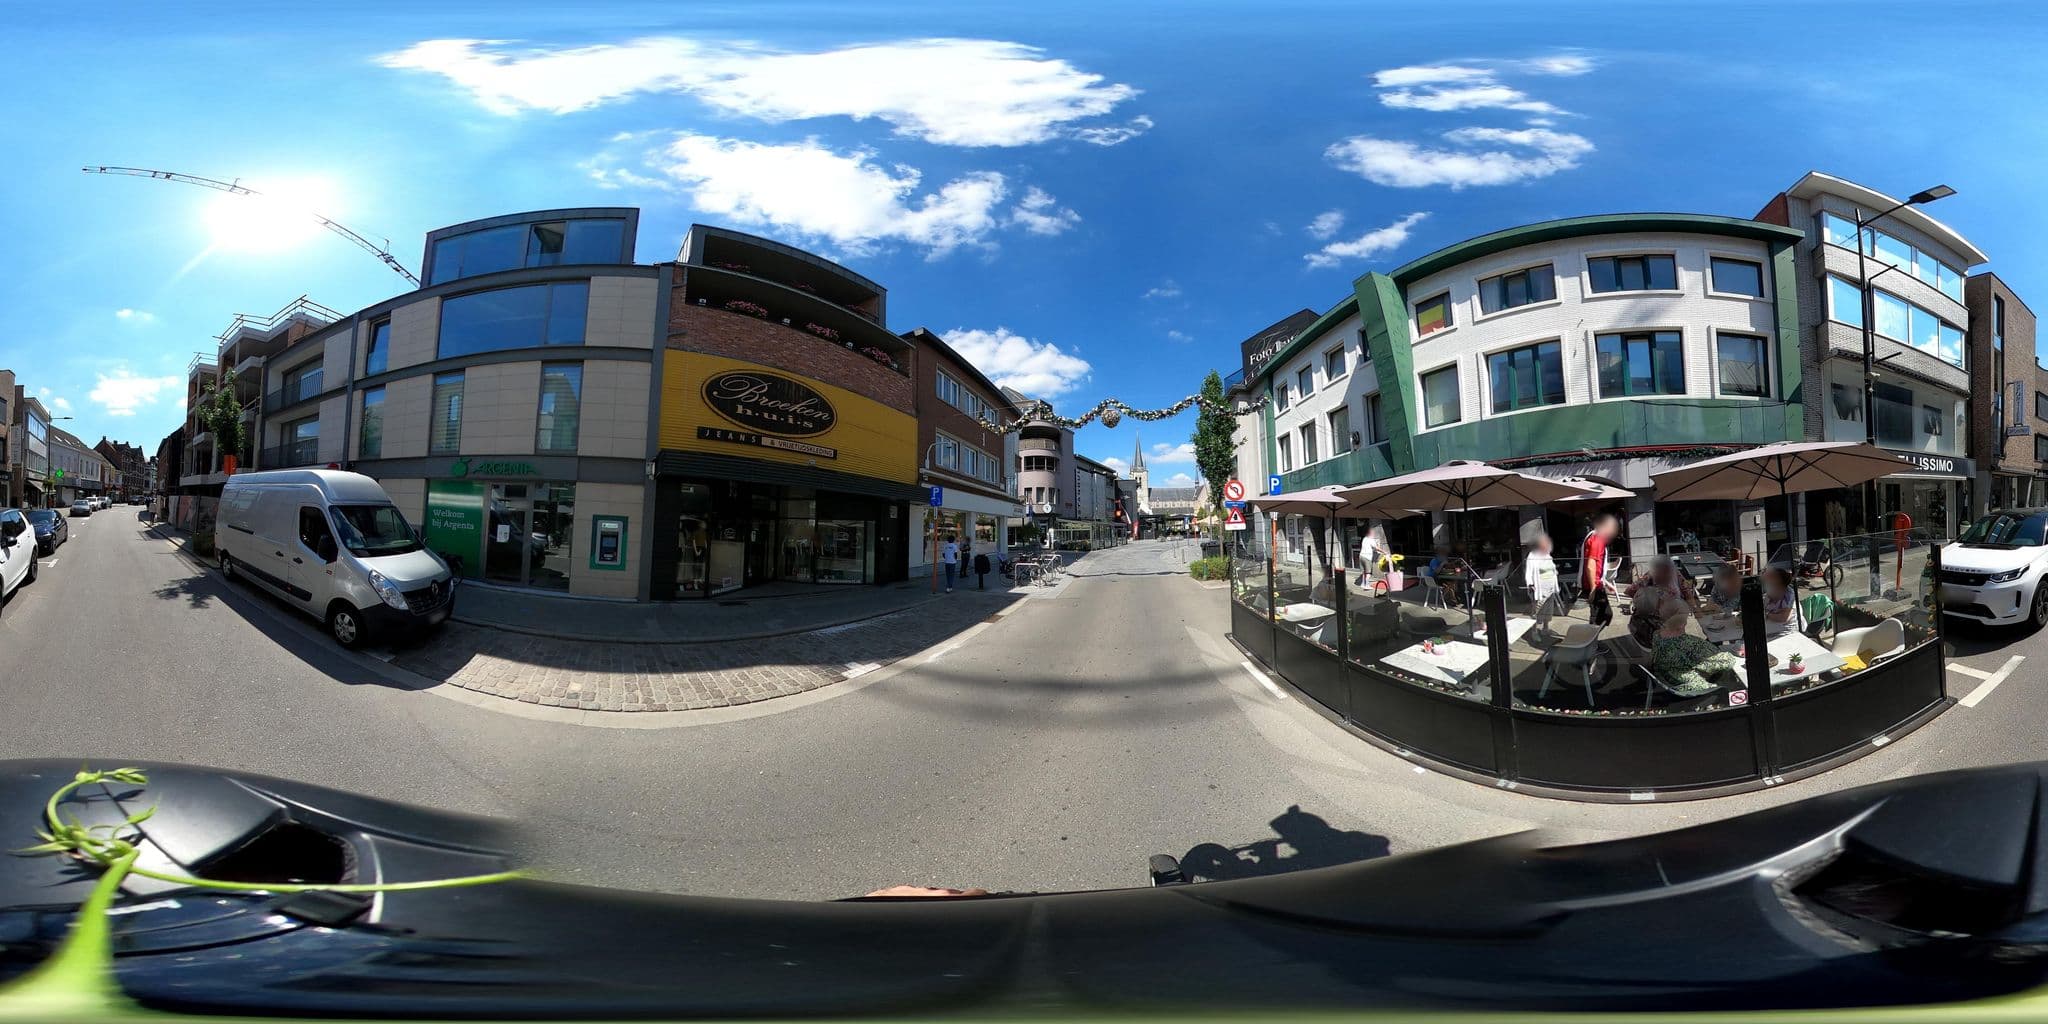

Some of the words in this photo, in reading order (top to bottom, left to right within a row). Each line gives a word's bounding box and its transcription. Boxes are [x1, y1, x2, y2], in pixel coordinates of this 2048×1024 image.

[1249, 347, 1273, 366] Foto
[712, 374, 831, 421] Broeken
[1270, 478, 1280, 492] P
[933, 488, 940, 498] P
[432, 509, 465, 518] Welkom
[432, 519, 442, 529] bij
[443, 520, 474, 531] Argenta
